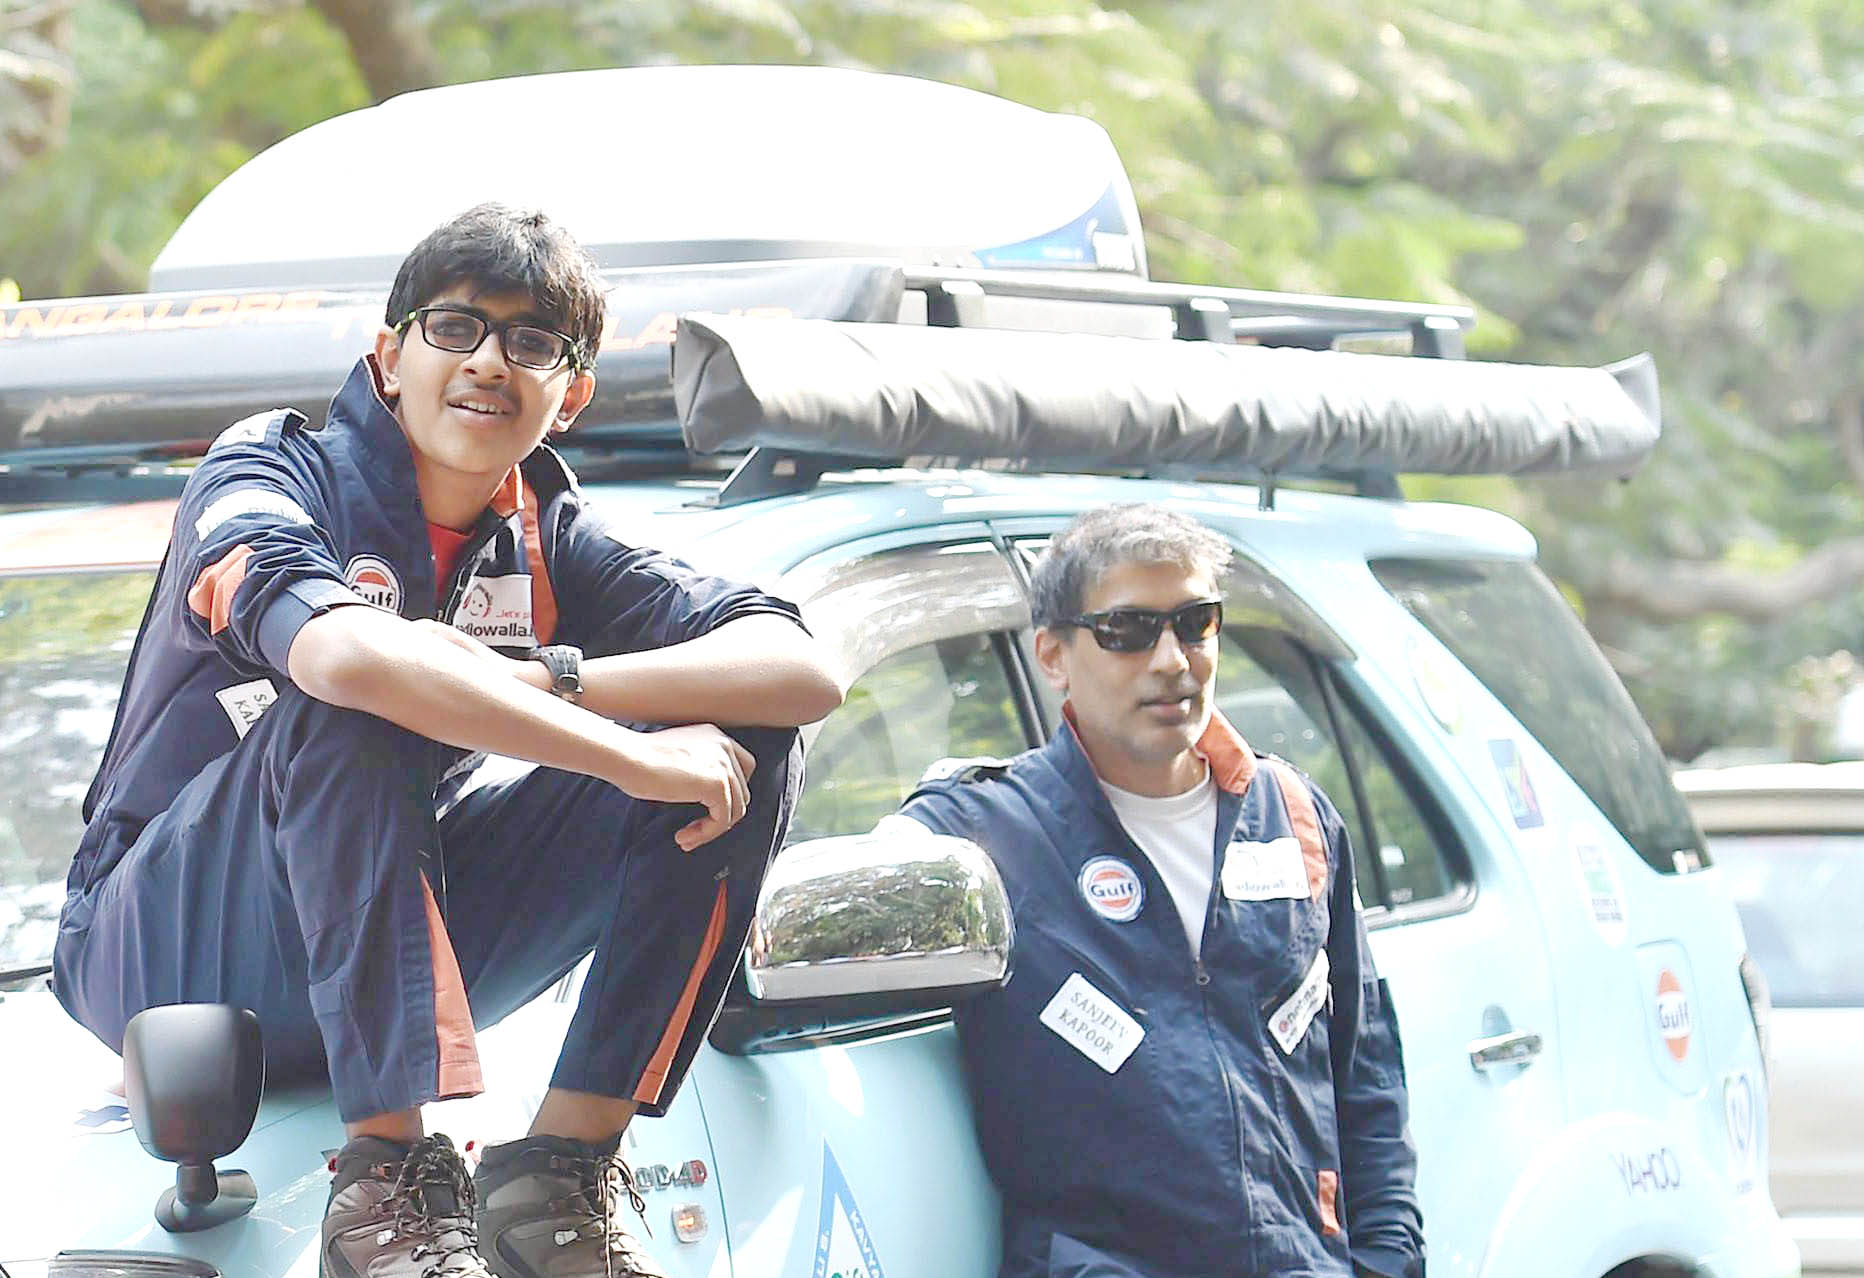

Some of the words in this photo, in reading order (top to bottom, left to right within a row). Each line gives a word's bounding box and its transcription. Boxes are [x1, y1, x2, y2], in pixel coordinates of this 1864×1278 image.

[1090, 882, 1135, 898] Gulf
[1058, 1008, 1115, 1056] KAPOOR
[1610, 1147, 1682, 1196] YAHOO
